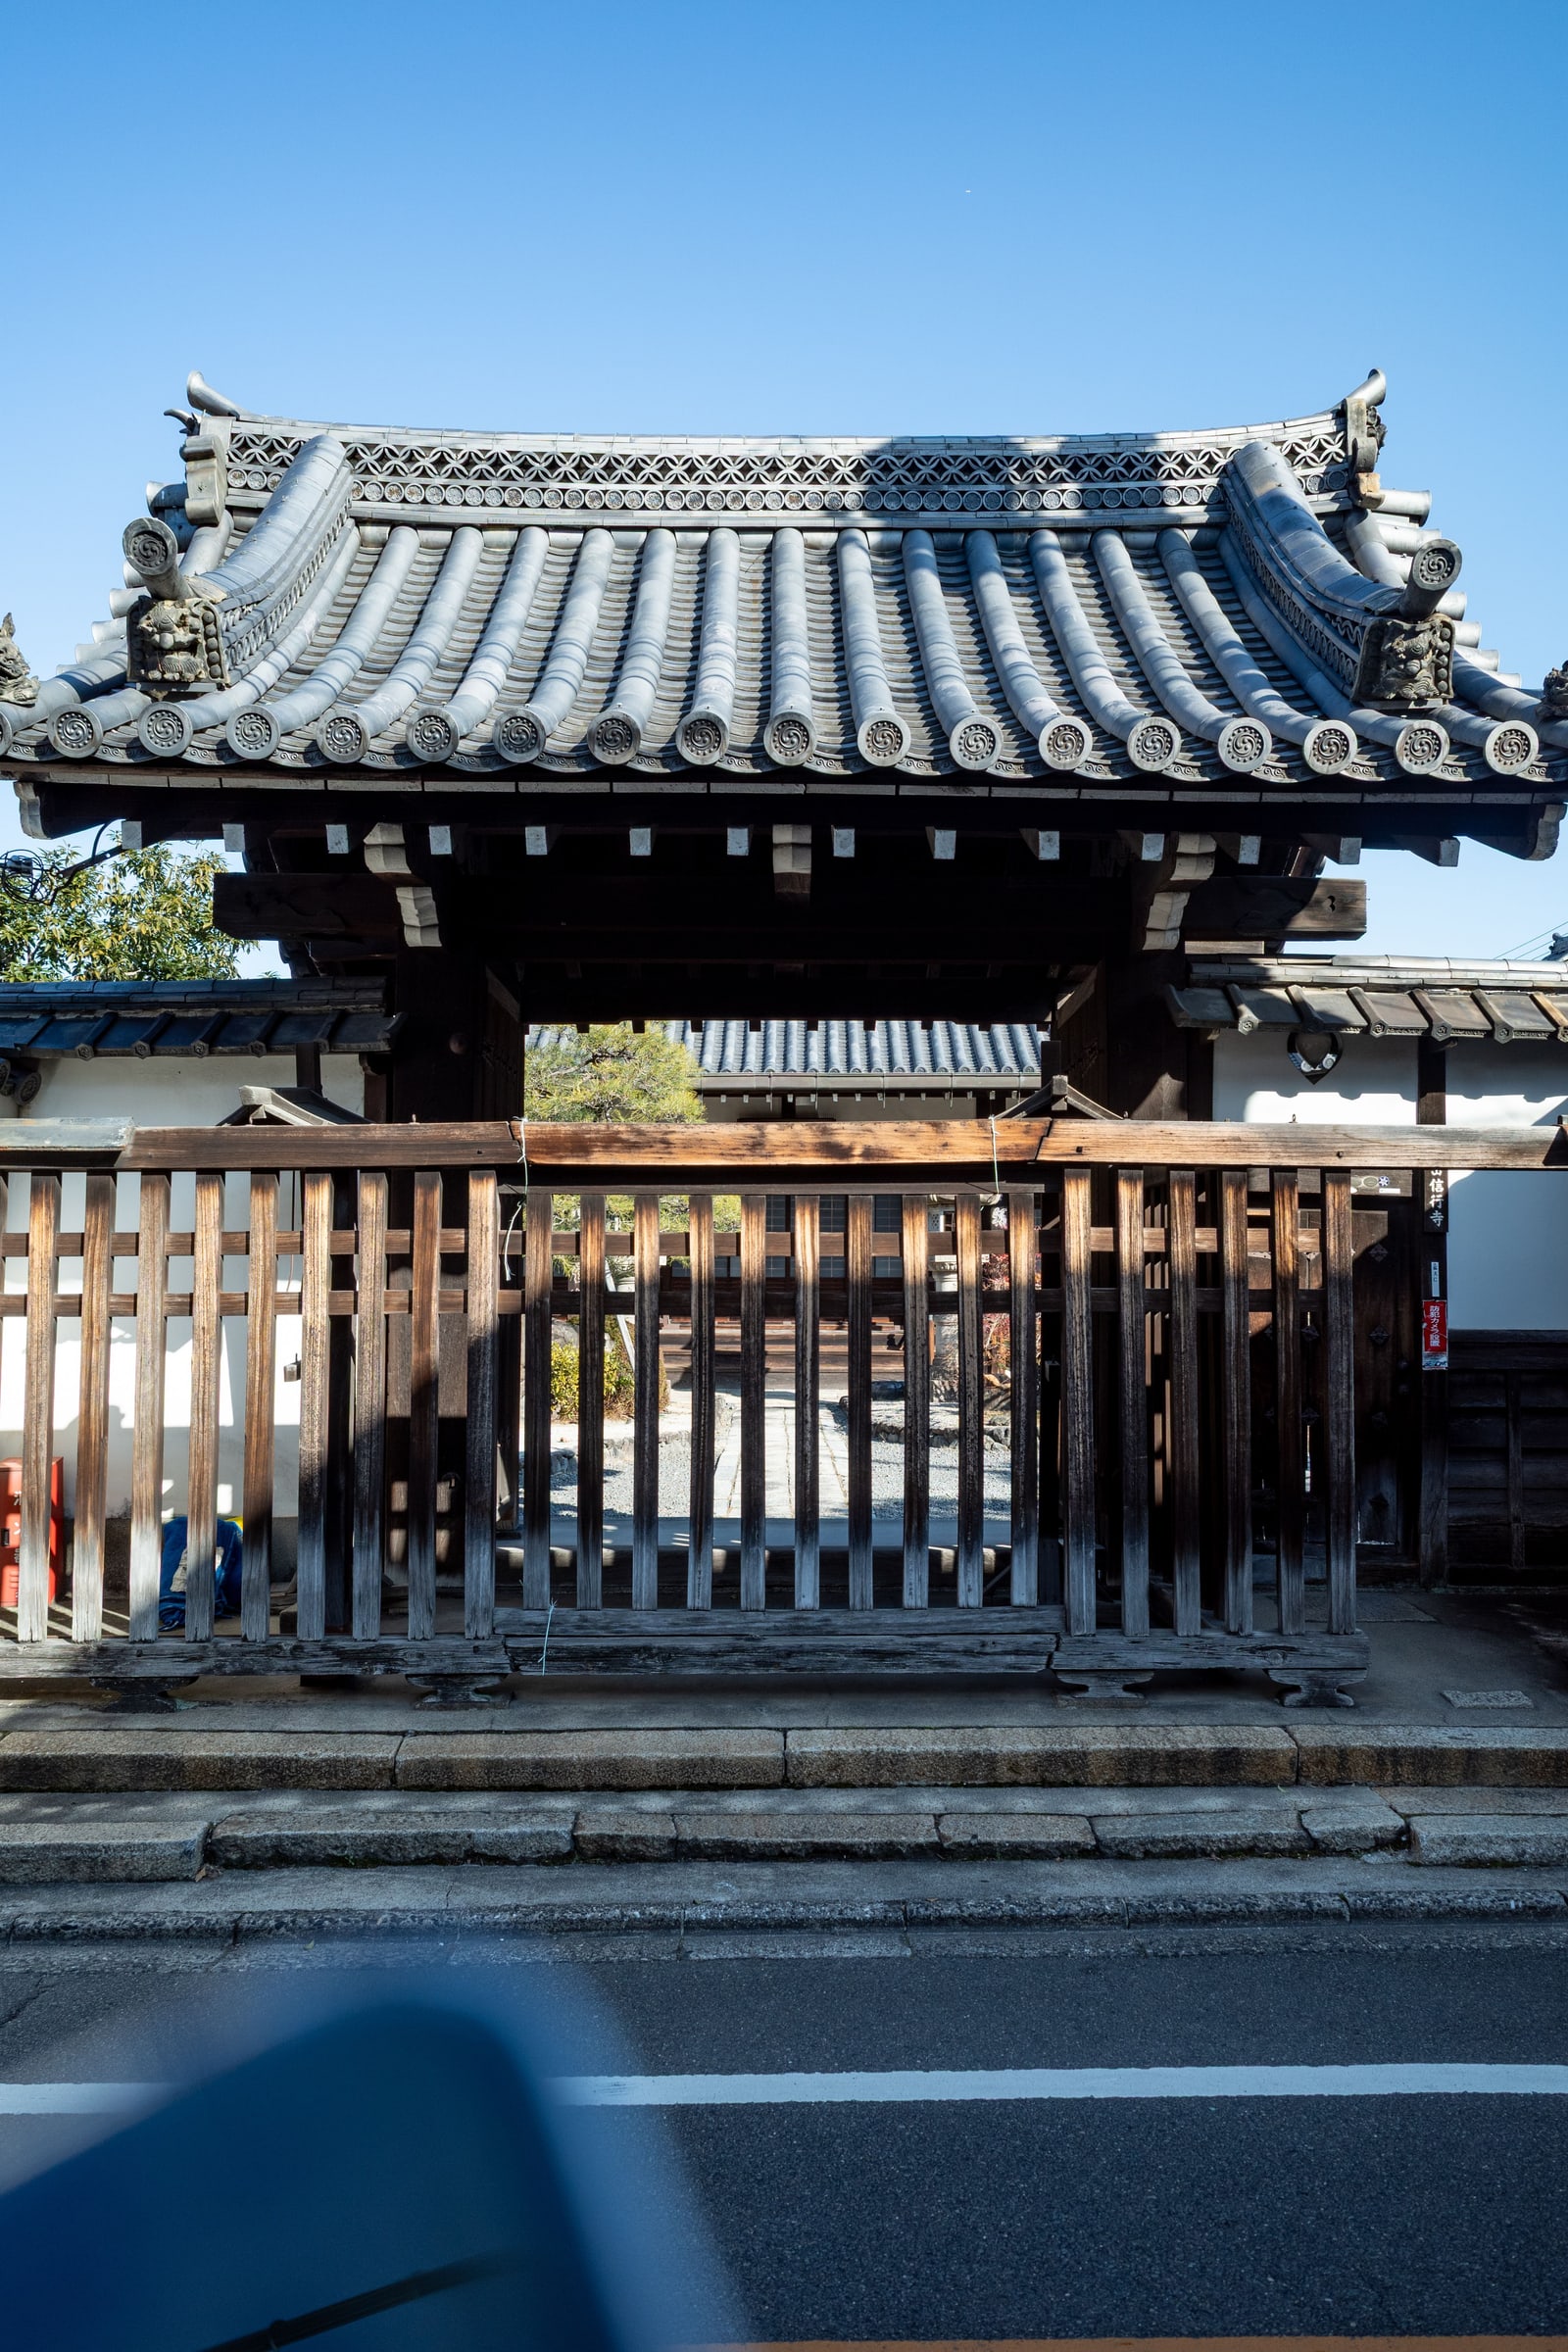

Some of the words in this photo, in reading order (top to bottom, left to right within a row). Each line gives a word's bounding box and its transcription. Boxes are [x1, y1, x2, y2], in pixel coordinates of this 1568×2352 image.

[1429, 1305, 1441, 1348] 防犯カメラ設置
